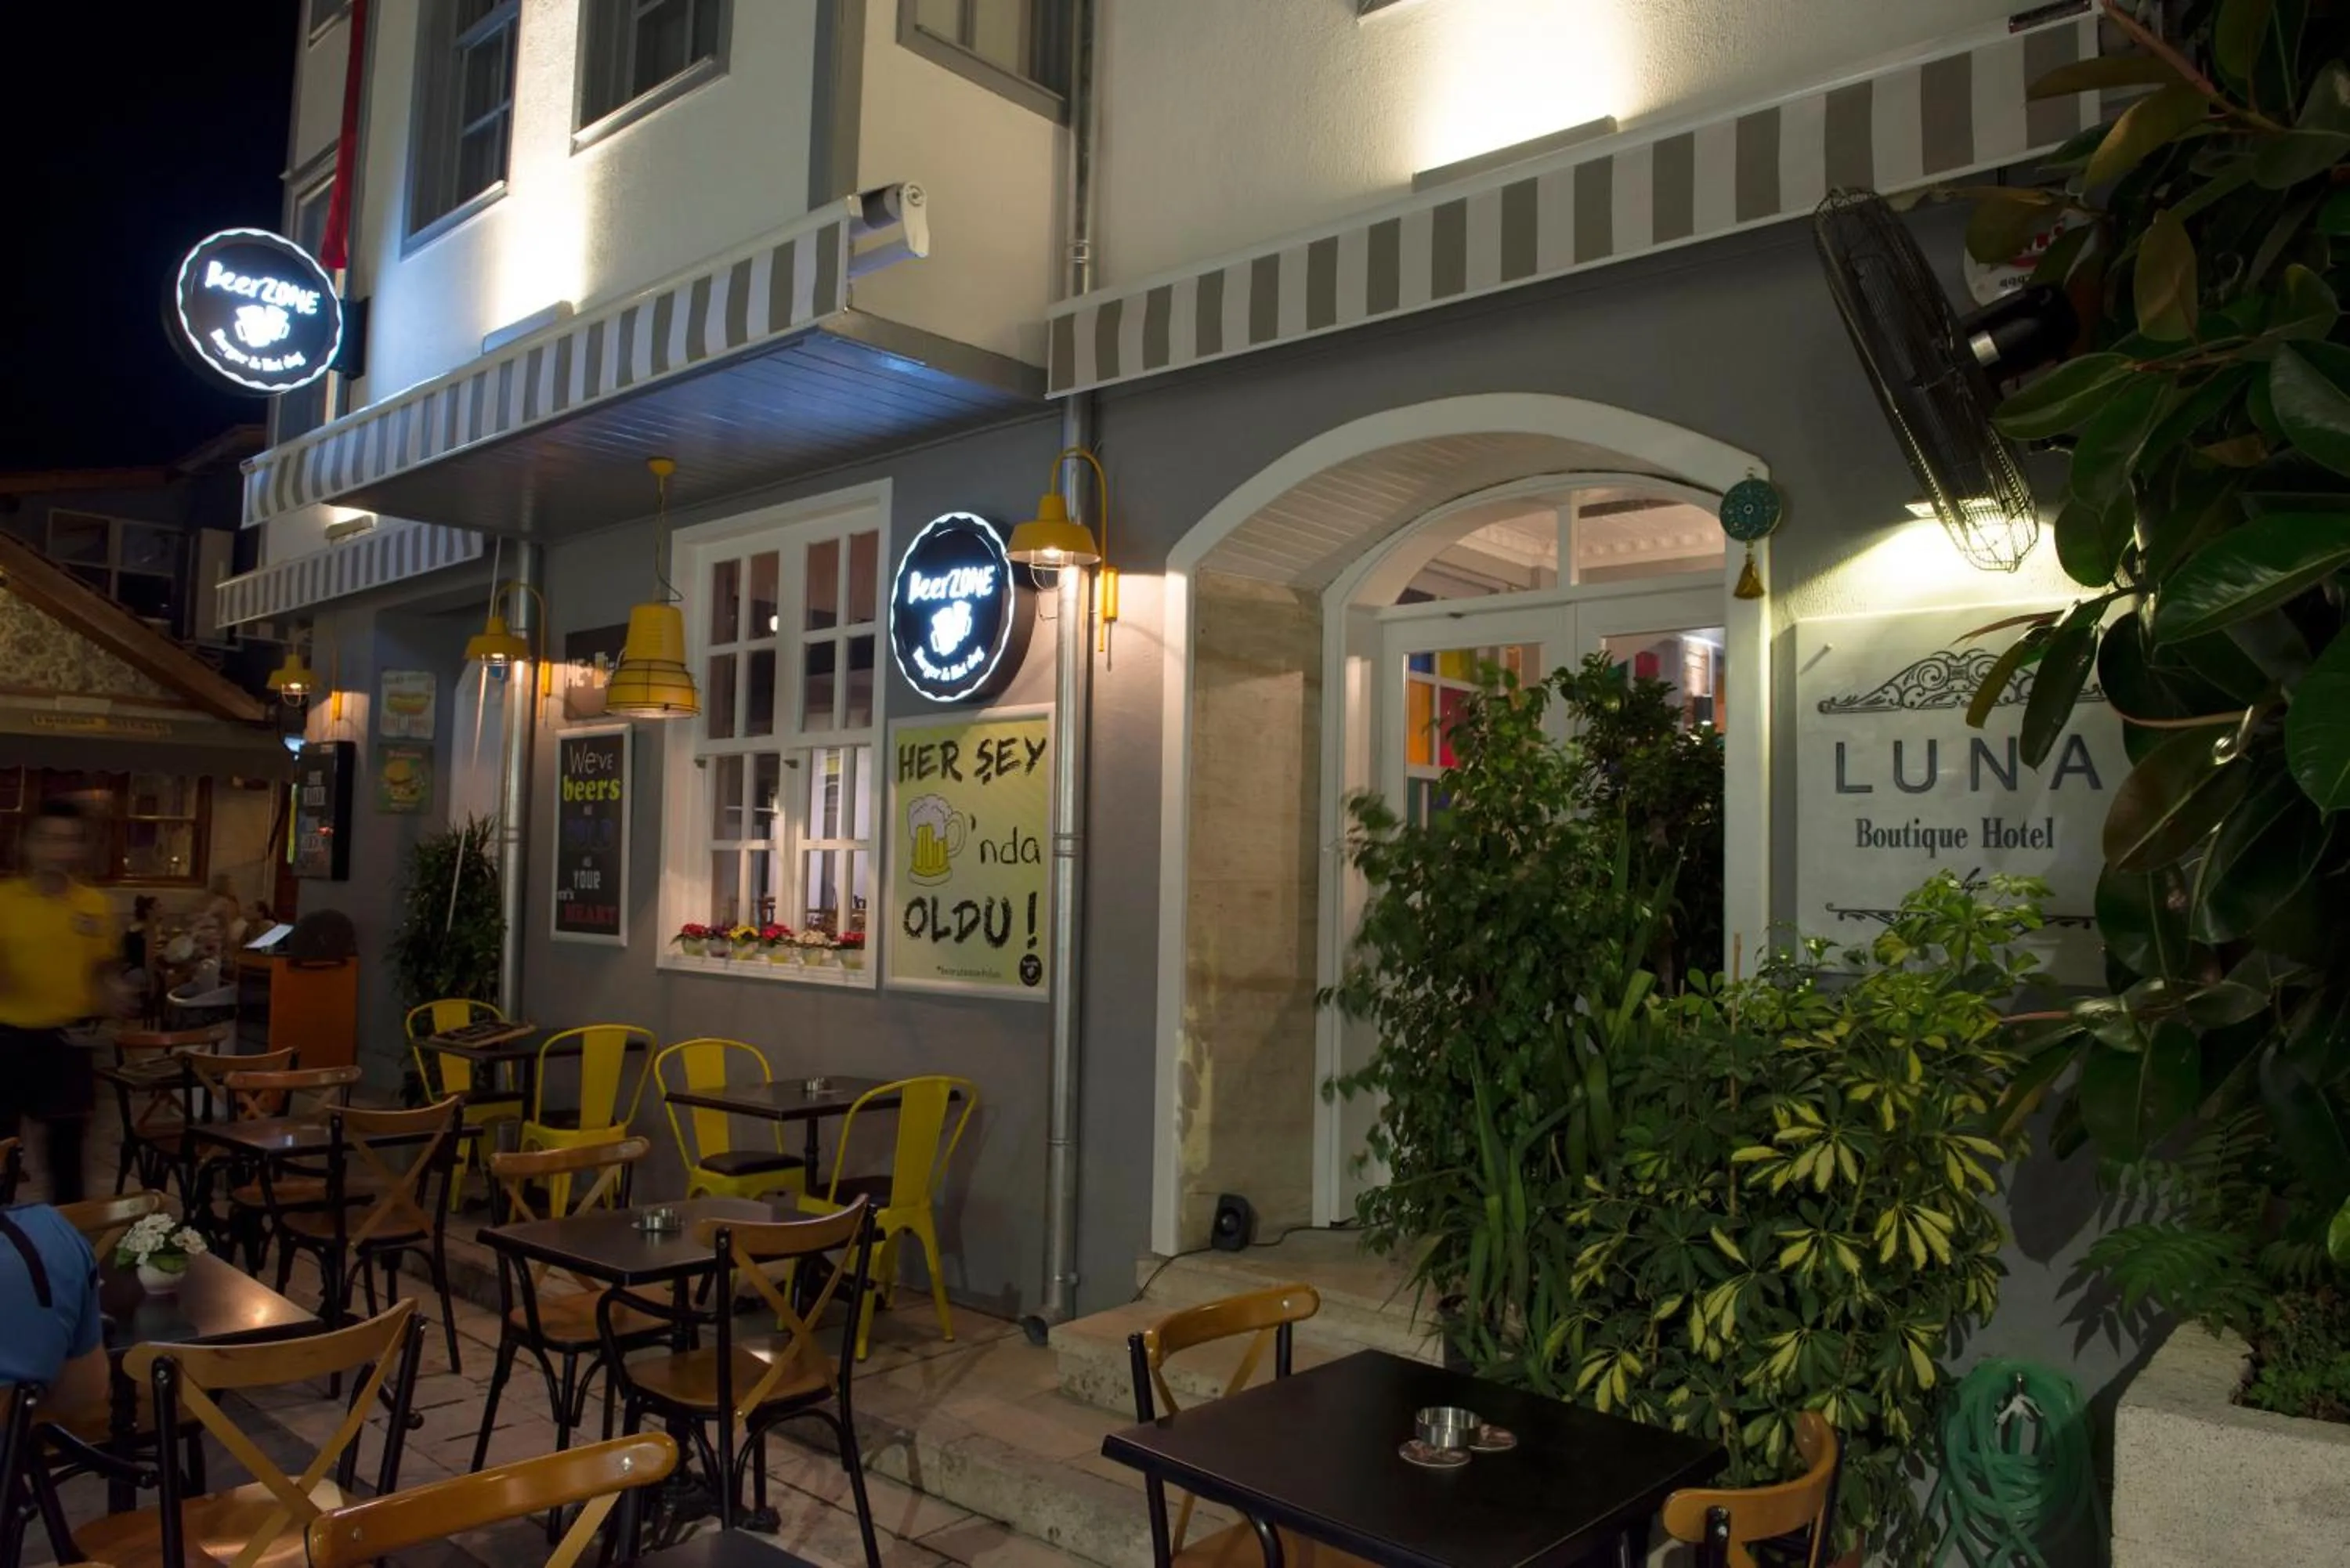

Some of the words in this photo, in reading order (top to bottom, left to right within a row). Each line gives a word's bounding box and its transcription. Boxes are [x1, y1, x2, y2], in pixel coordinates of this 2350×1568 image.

[898, 738, 962, 783] HER
[1835, 734, 2103, 794] LUNA
[562, 775, 621, 802] beers
[1855, 817, 1969, 858] Boutique
[1981, 816, 2054, 849] Hotel
[573, 870, 601, 890] YOUR
